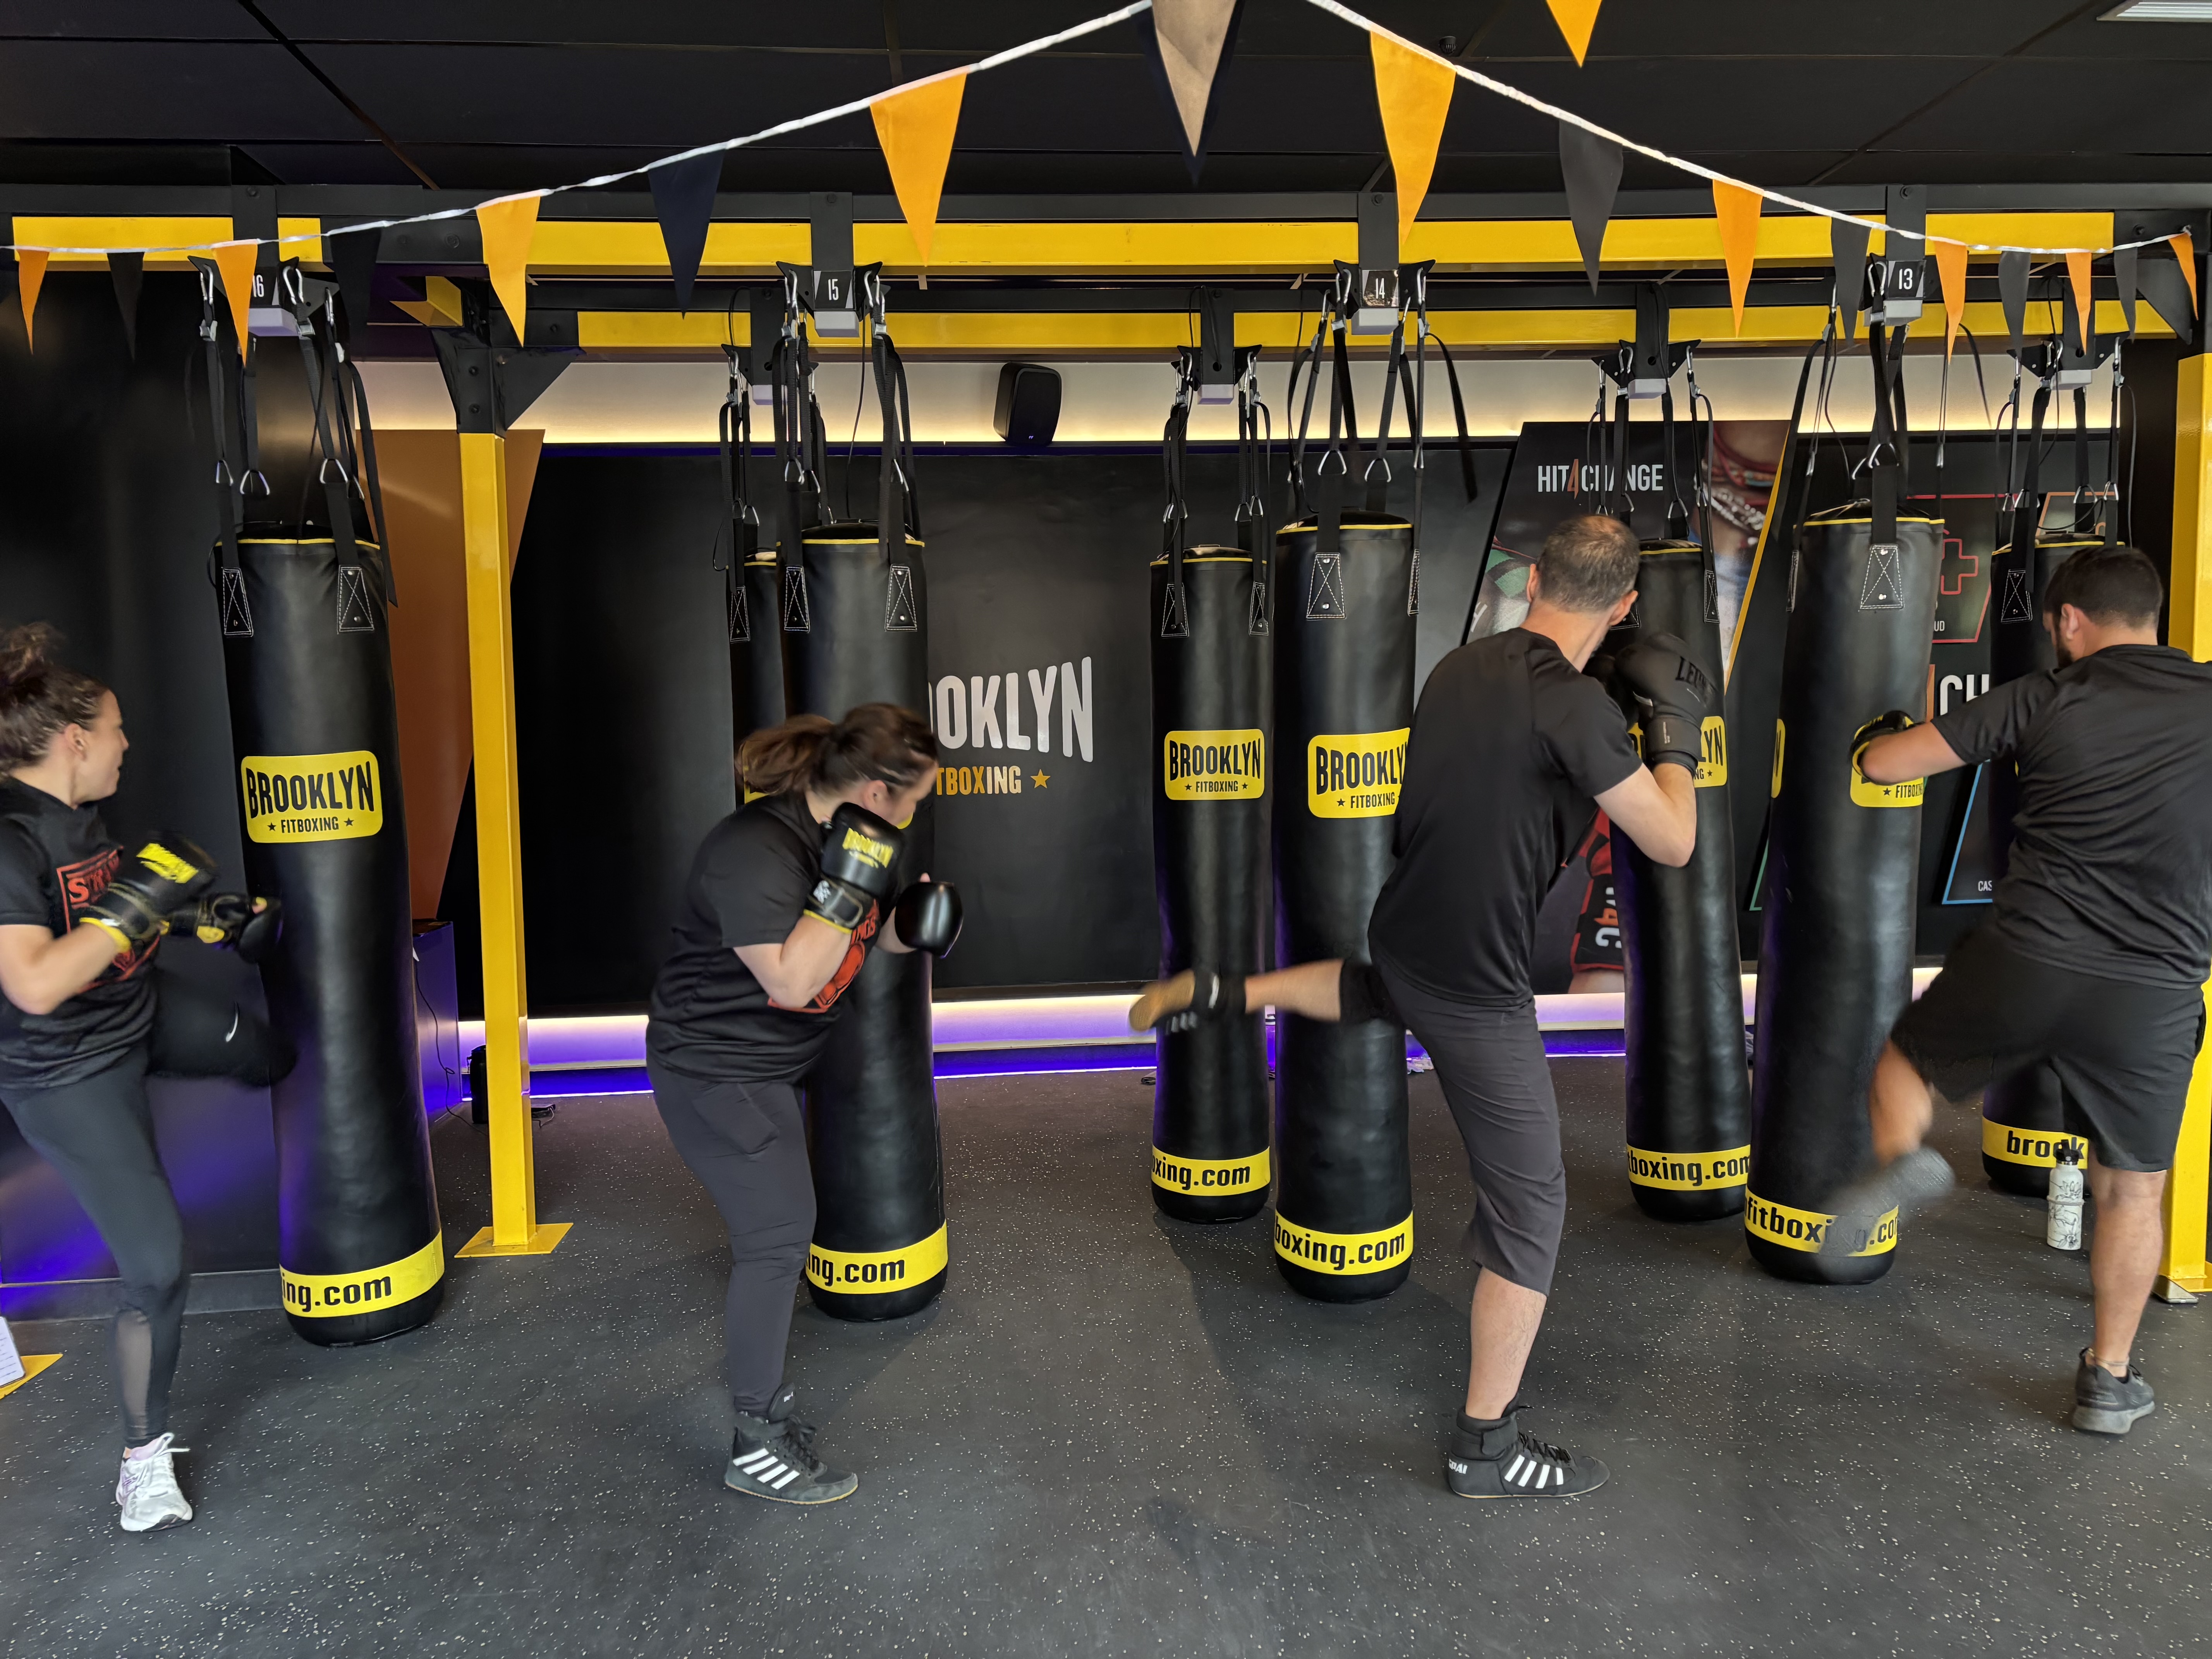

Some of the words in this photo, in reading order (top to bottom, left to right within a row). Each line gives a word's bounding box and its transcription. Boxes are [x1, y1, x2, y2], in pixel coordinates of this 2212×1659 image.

[1376, 278, 1385, 299] 14
[1899, 268, 1913, 290] 13
[828, 279, 839, 301] 15
[1934, 620, 1945, 632] UD
[928, 656, 1093, 763] OKLYN
[1170, 738, 1261, 781] BROOKLYN
[1316, 741, 1407, 795] BROOKLY
[1694, 768, 1704, 780] NG
[246, 761, 374, 819] BROOKLYN
[1196, 780, 1238, 793] FITBOXING
[1350, 792, 1395, 809] FITBOXING
[280, 816, 339, 837] FITBOXING
[1978, 880, 1992, 891] CAS
[806, 1252, 905, 1287] ing.com
